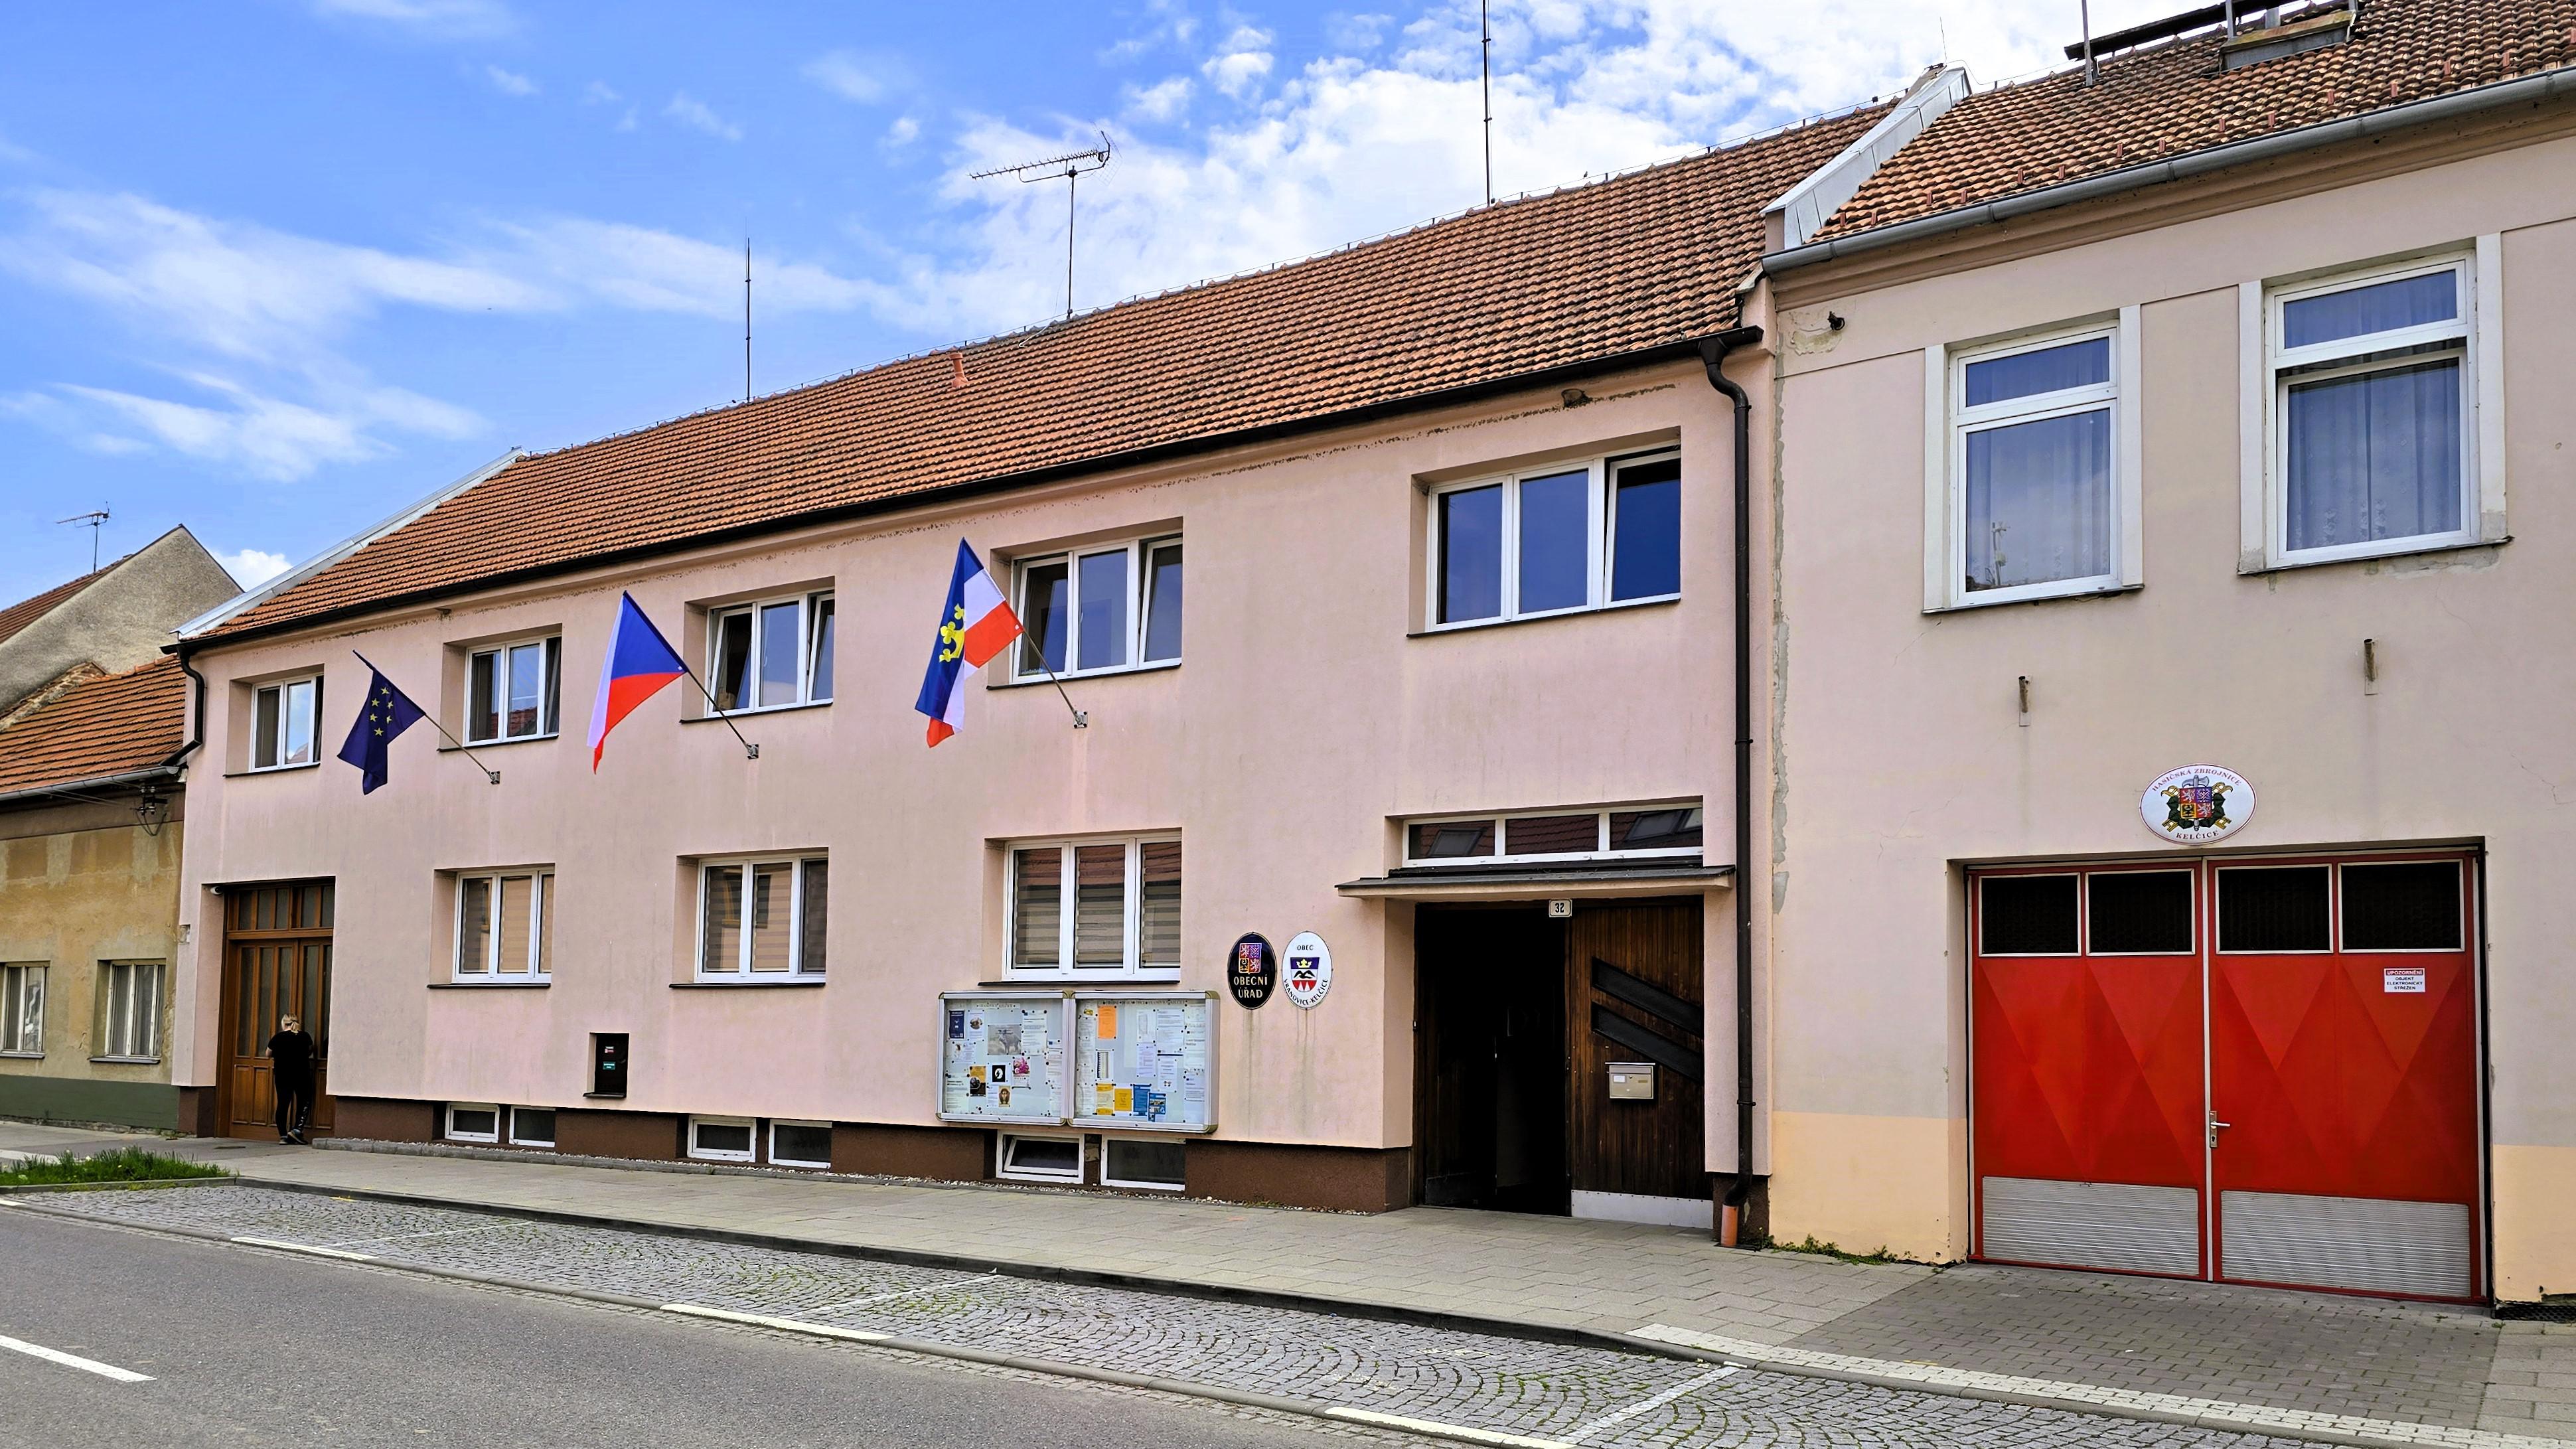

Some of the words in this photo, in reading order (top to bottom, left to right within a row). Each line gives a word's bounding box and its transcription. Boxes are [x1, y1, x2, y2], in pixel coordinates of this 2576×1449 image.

[2152, 769, 2192, 792] HASIČSKÁ
[2194, 768, 2243, 786] ZBROJNICE
[2176, 830, 2219, 840] KELČICE
[1554, 902, 1564, 913] 32
[1233, 974, 1268, 986] OBECNÍ
[1238, 986, 1263, 998] ÚŘAD
